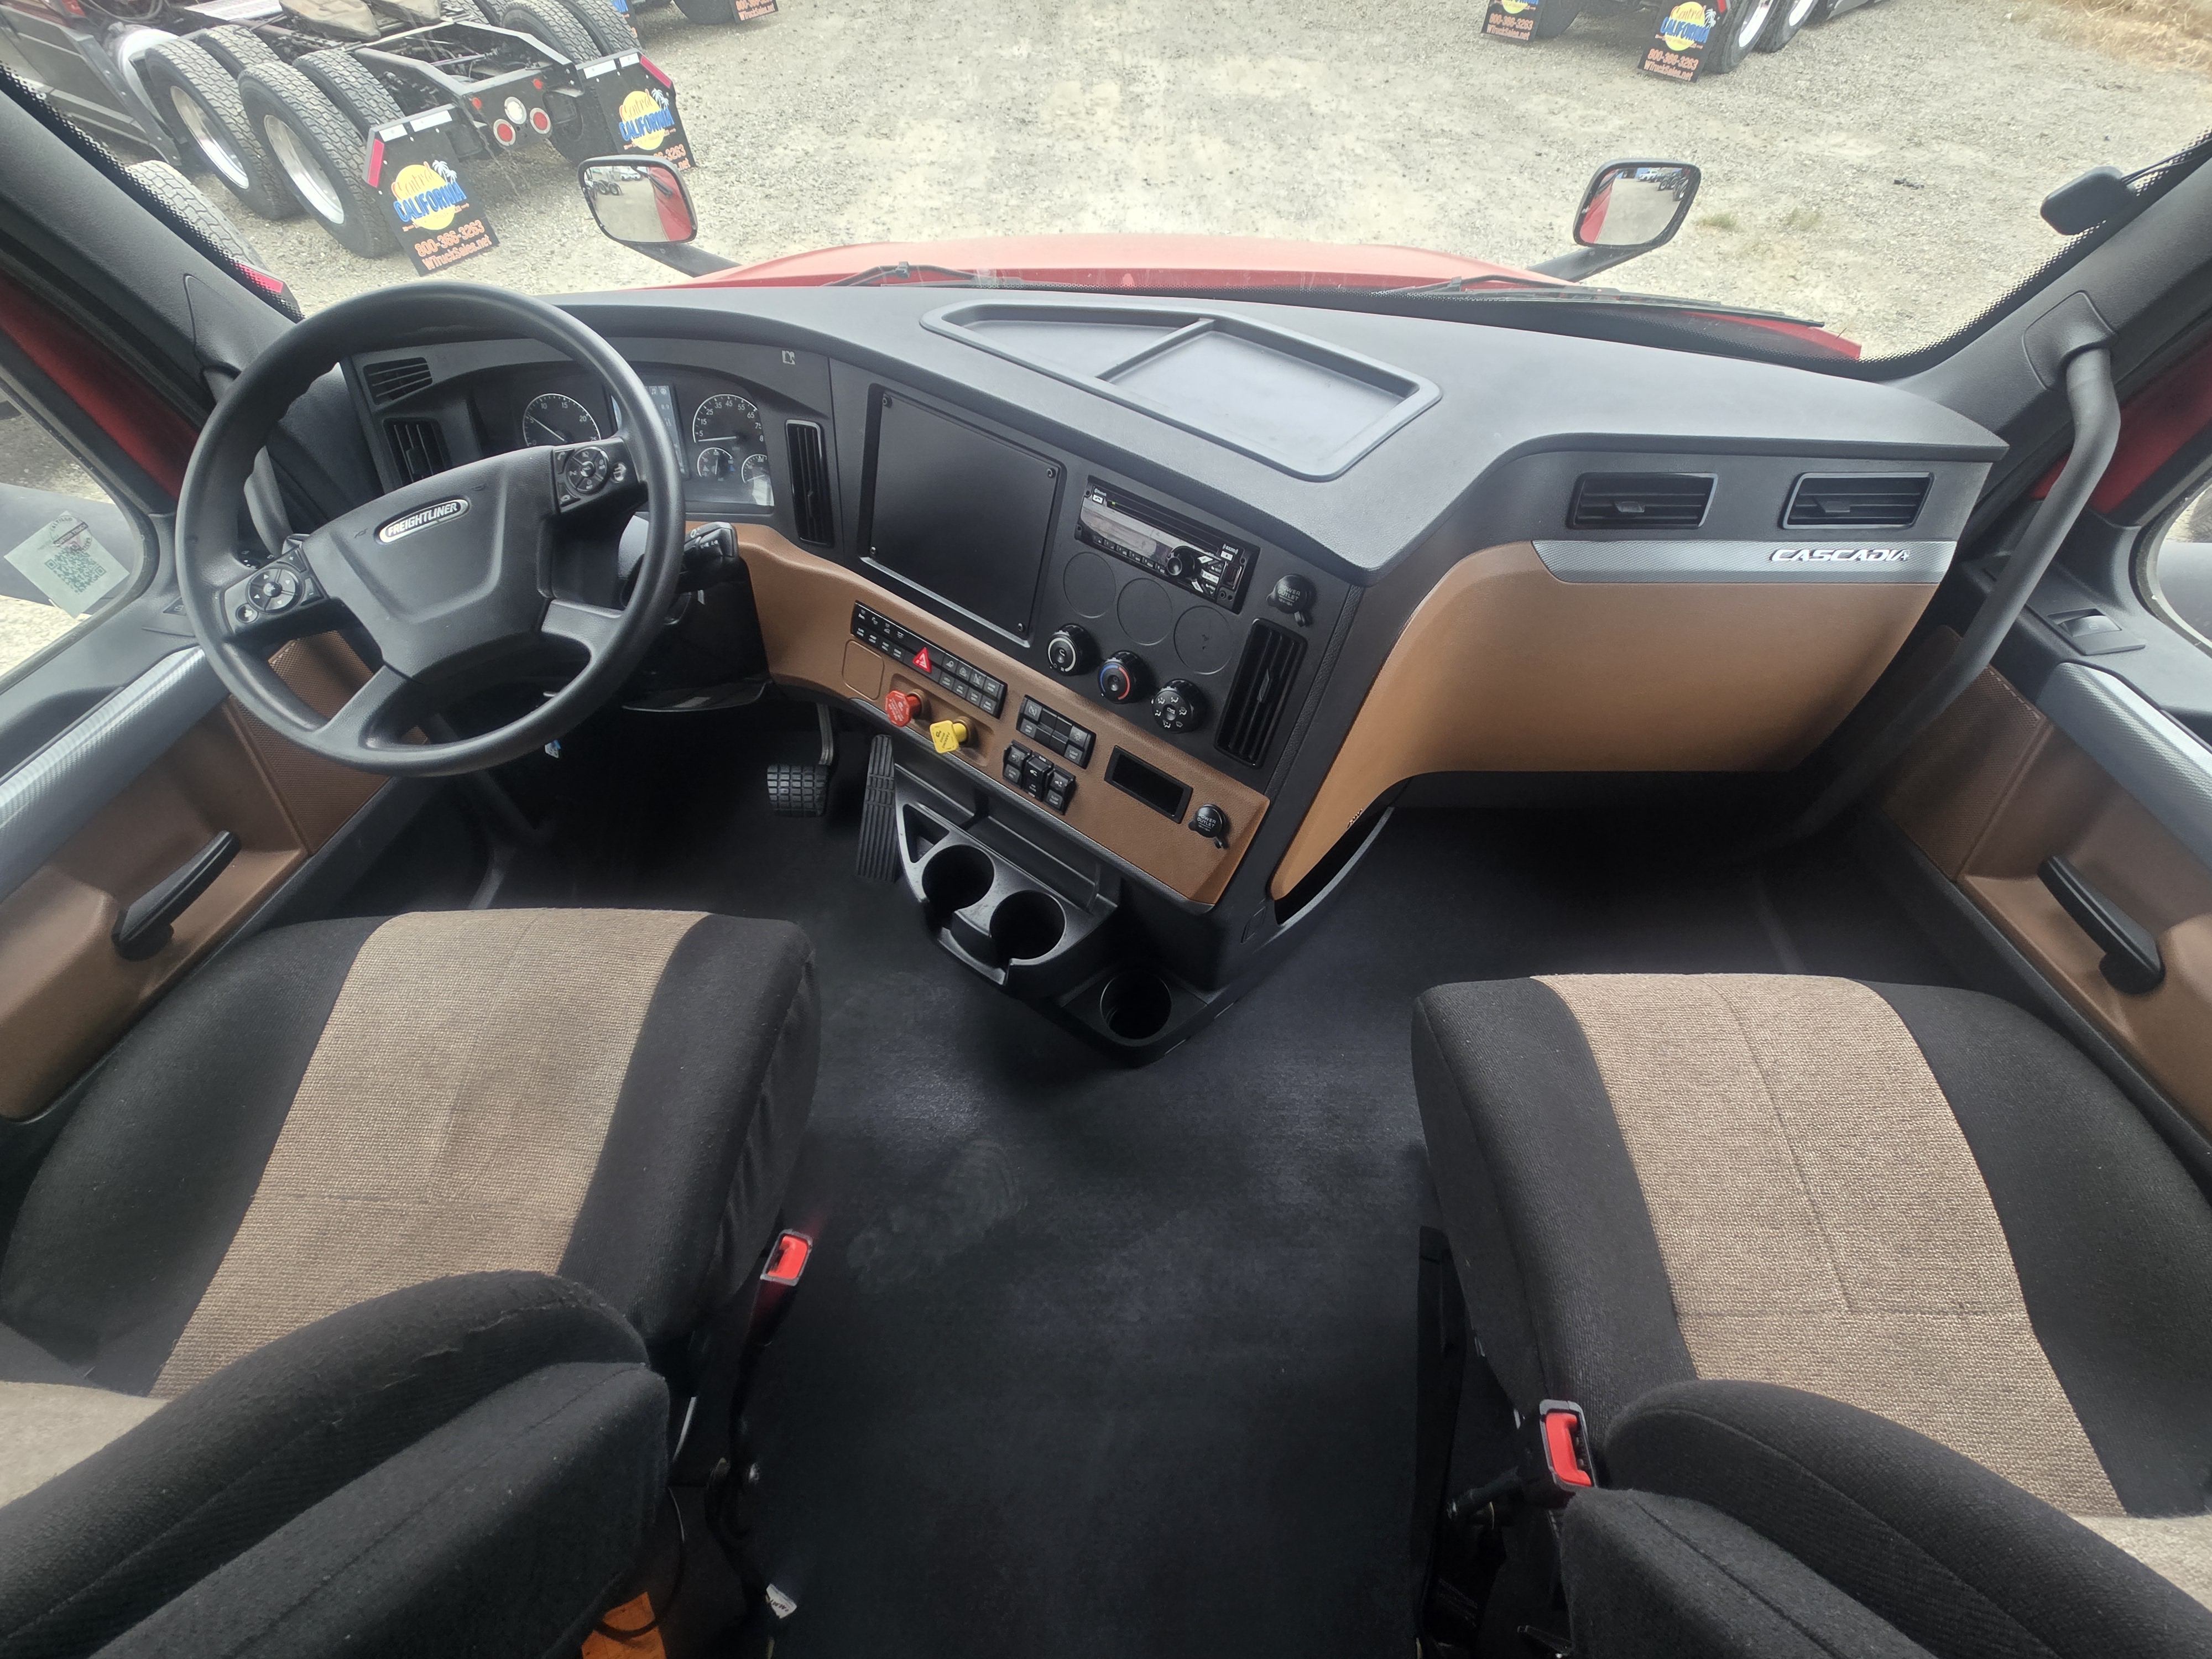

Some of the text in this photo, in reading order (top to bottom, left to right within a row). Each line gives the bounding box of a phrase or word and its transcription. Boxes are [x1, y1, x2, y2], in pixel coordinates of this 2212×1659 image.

[1671, 5, 1707, 20] Central
[1660, 16, 1710, 43] CALIFORNIA
[619, 88, 653, 122] Central
[619, 107, 675, 141] CALIFORNIA
[391, 161, 436, 201] Central
[393, 181, 467, 222] CALIFORNIA
[415, 220, 485, 257] 800-366-3263
[422, 234, 492, 270] WTruckSales.net
[388, 502, 458, 536] FREIGHTLINER
[1770, 549, 1910, 562] CASCADIA
[1277, 588, 1299, 601] OUTLET
[1280, 584, 1301, 596] POWER
[942, 732, 950, 749] PARKING
[1197, 817, 1215, 827] OUTLET
[1198, 813, 1216, 823] POWER
